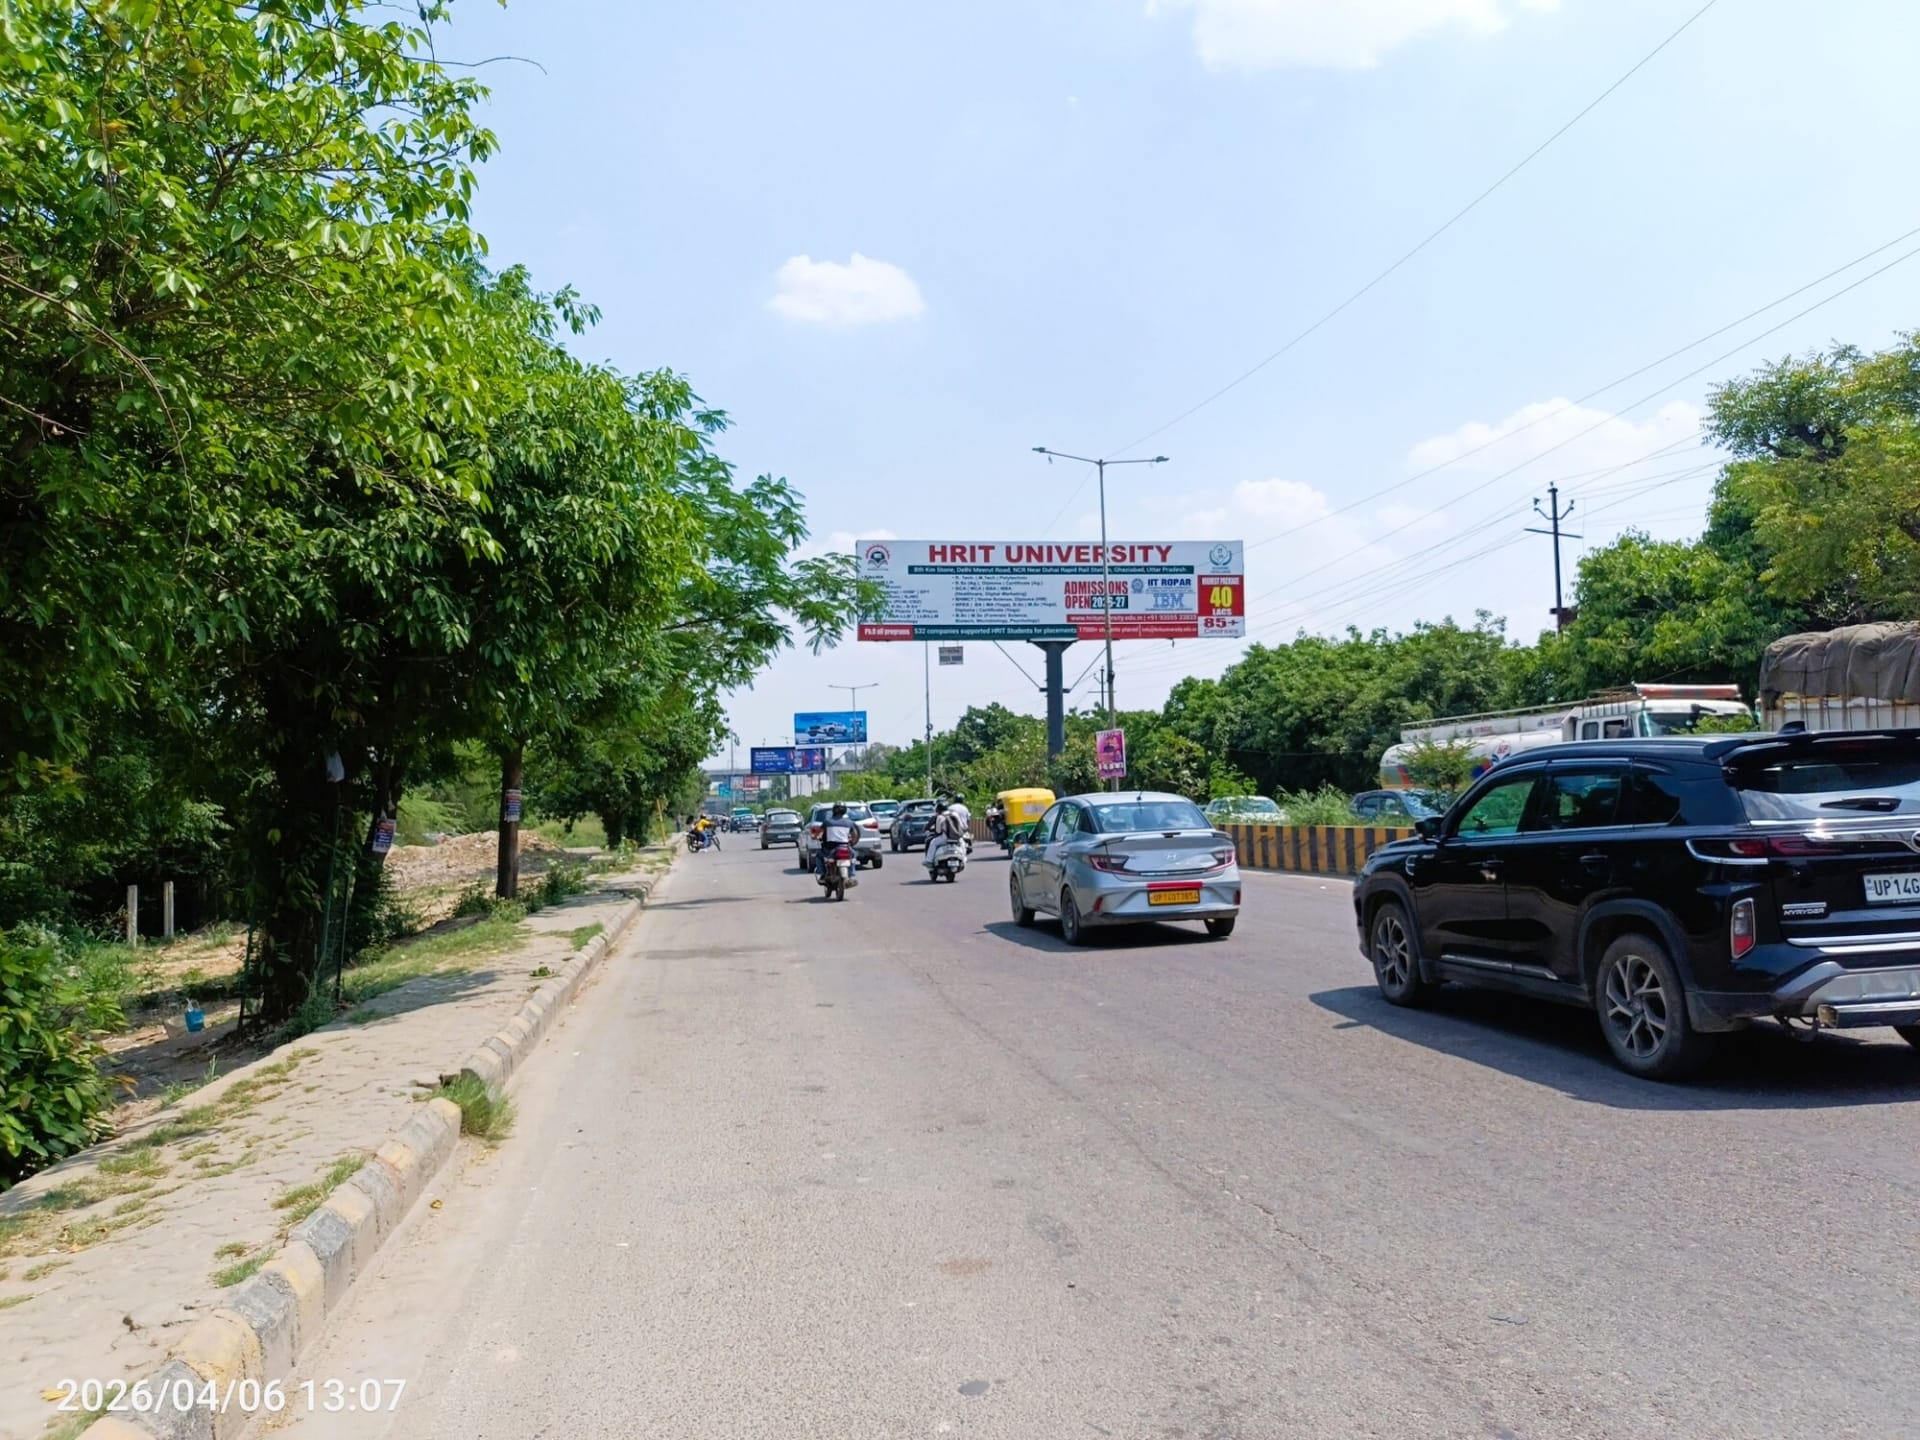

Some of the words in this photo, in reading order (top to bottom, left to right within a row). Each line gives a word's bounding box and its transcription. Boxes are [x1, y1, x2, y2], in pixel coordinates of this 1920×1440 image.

[929, 544, 996, 563] HRIT
[1005, 544, 1172, 563] UNIVERSITY
[1064, 581, 1128, 595] ADMISSONS
[1065, 596, 1090, 608] OPEN
[1092, 596, 1126, 608] 206-27
[1153, 593, 1184, 608] IBM
[1210, 586, 1232, 607] 40
[1204, 618, 1238, 628] 85+
[1784, 908, 1825, 916] HYRYDER
